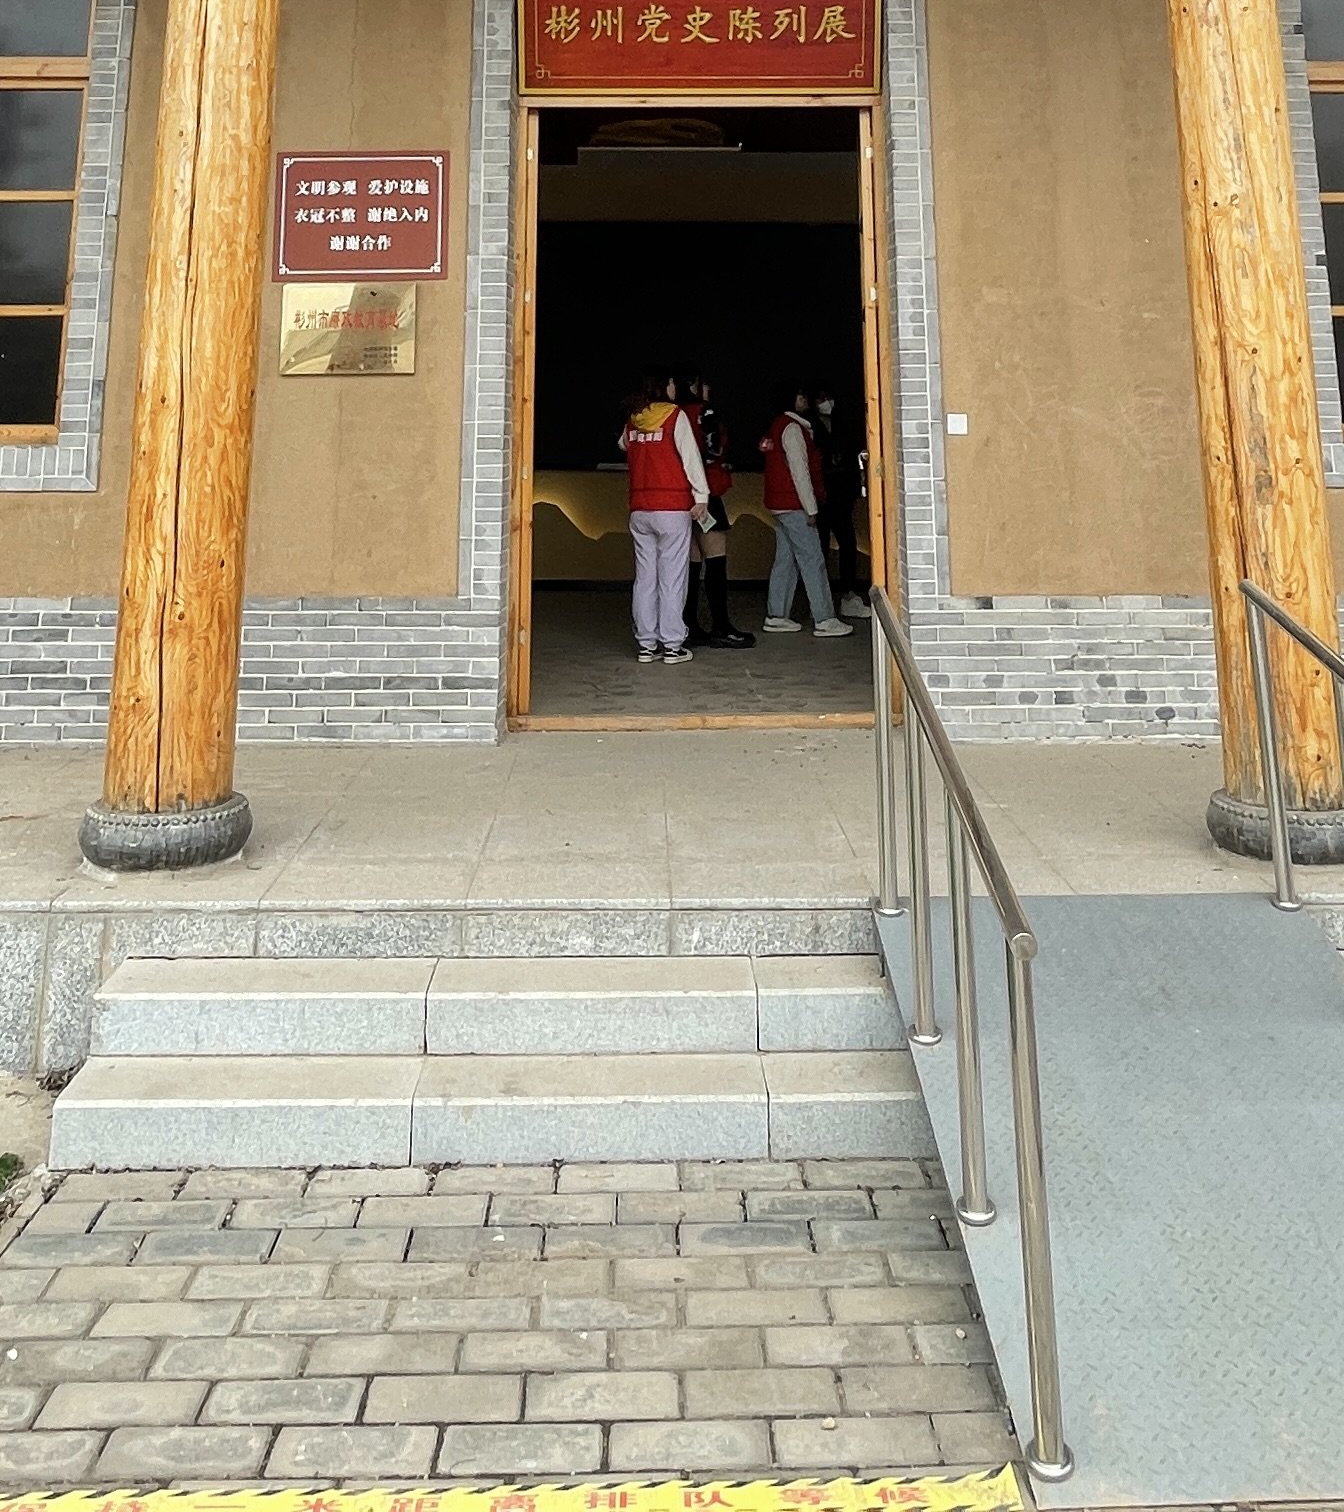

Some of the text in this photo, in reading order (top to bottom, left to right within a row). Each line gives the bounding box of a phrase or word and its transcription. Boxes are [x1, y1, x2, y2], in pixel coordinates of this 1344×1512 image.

[544, 2, 857, 46] 彬州党史陈列展
[295, 179, 430, 196] 文明参观 爱护设施
[294, 207, 430, 224] 衣冠不整 谢绝入内
[329, 235, 392, 252] 谢谢合作
